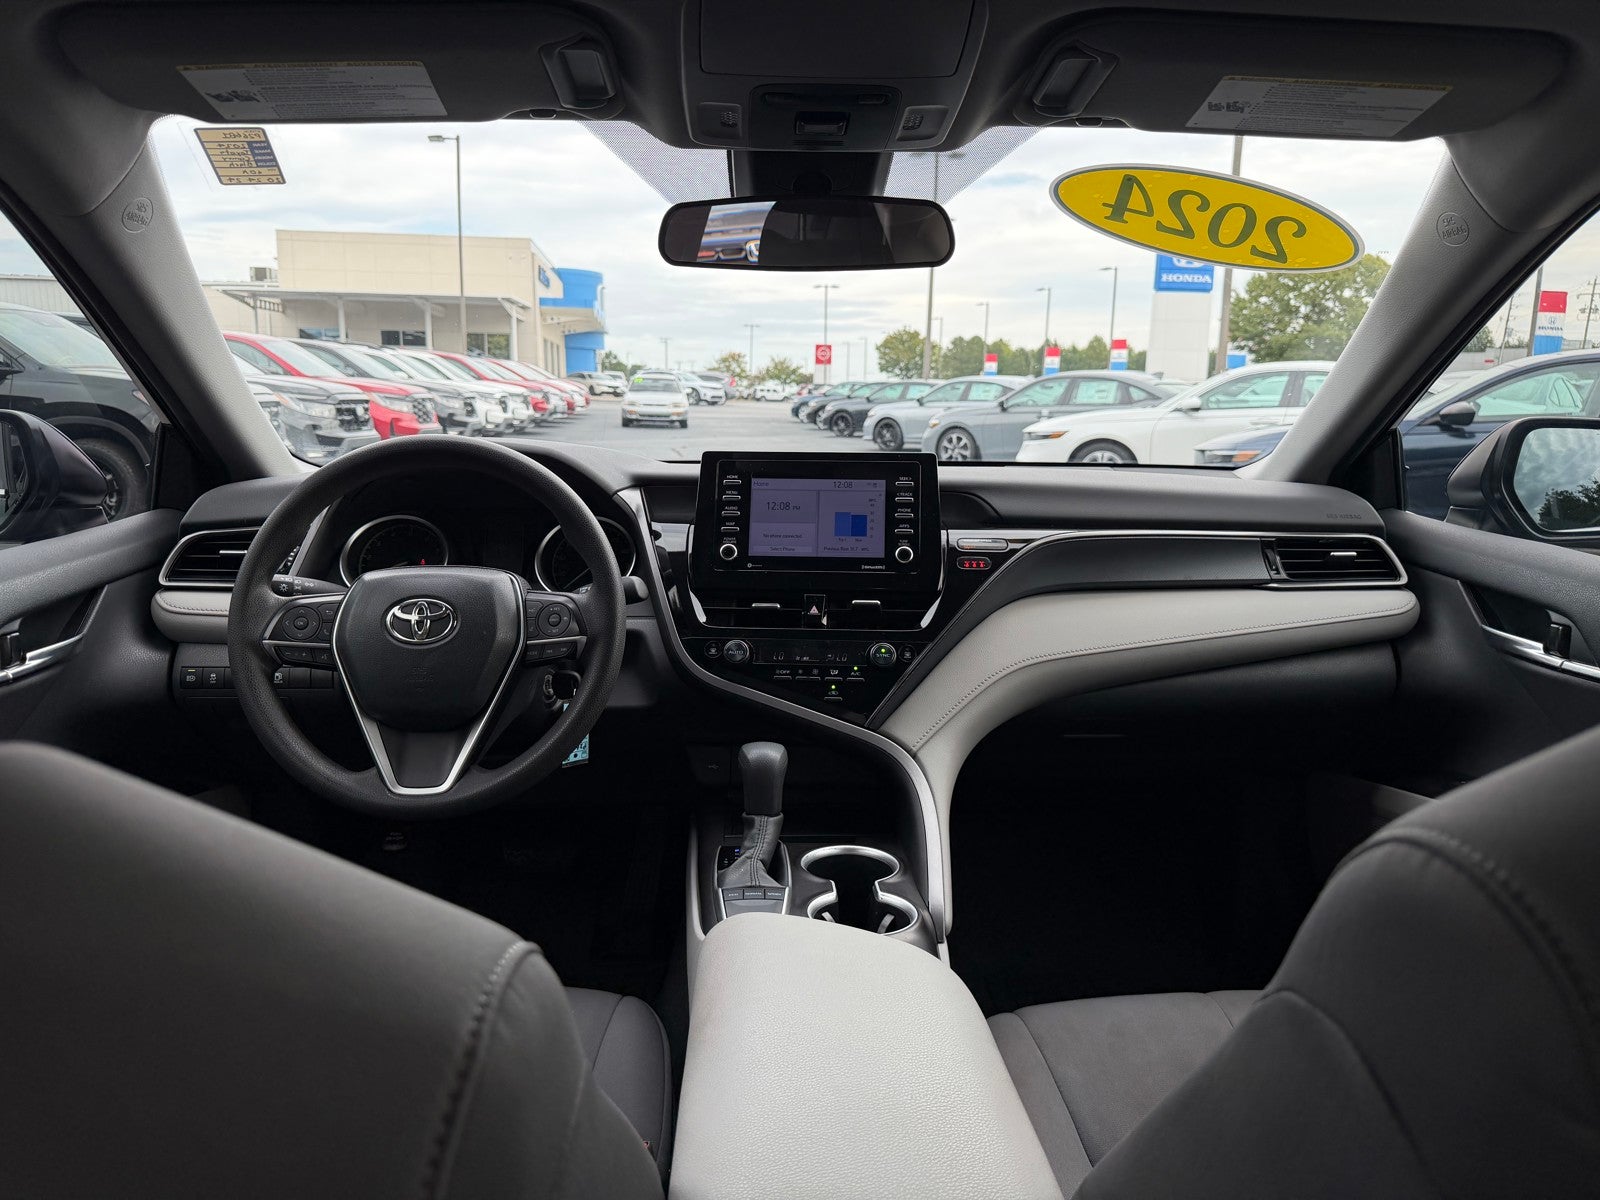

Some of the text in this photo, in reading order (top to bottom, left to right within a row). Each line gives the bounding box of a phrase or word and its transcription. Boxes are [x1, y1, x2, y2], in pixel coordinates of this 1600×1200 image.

[1160, 272, 1212, 285] HONDA
[833, 481, 853, 489] 12:08
[766, 501, 791, 511] 12:08
